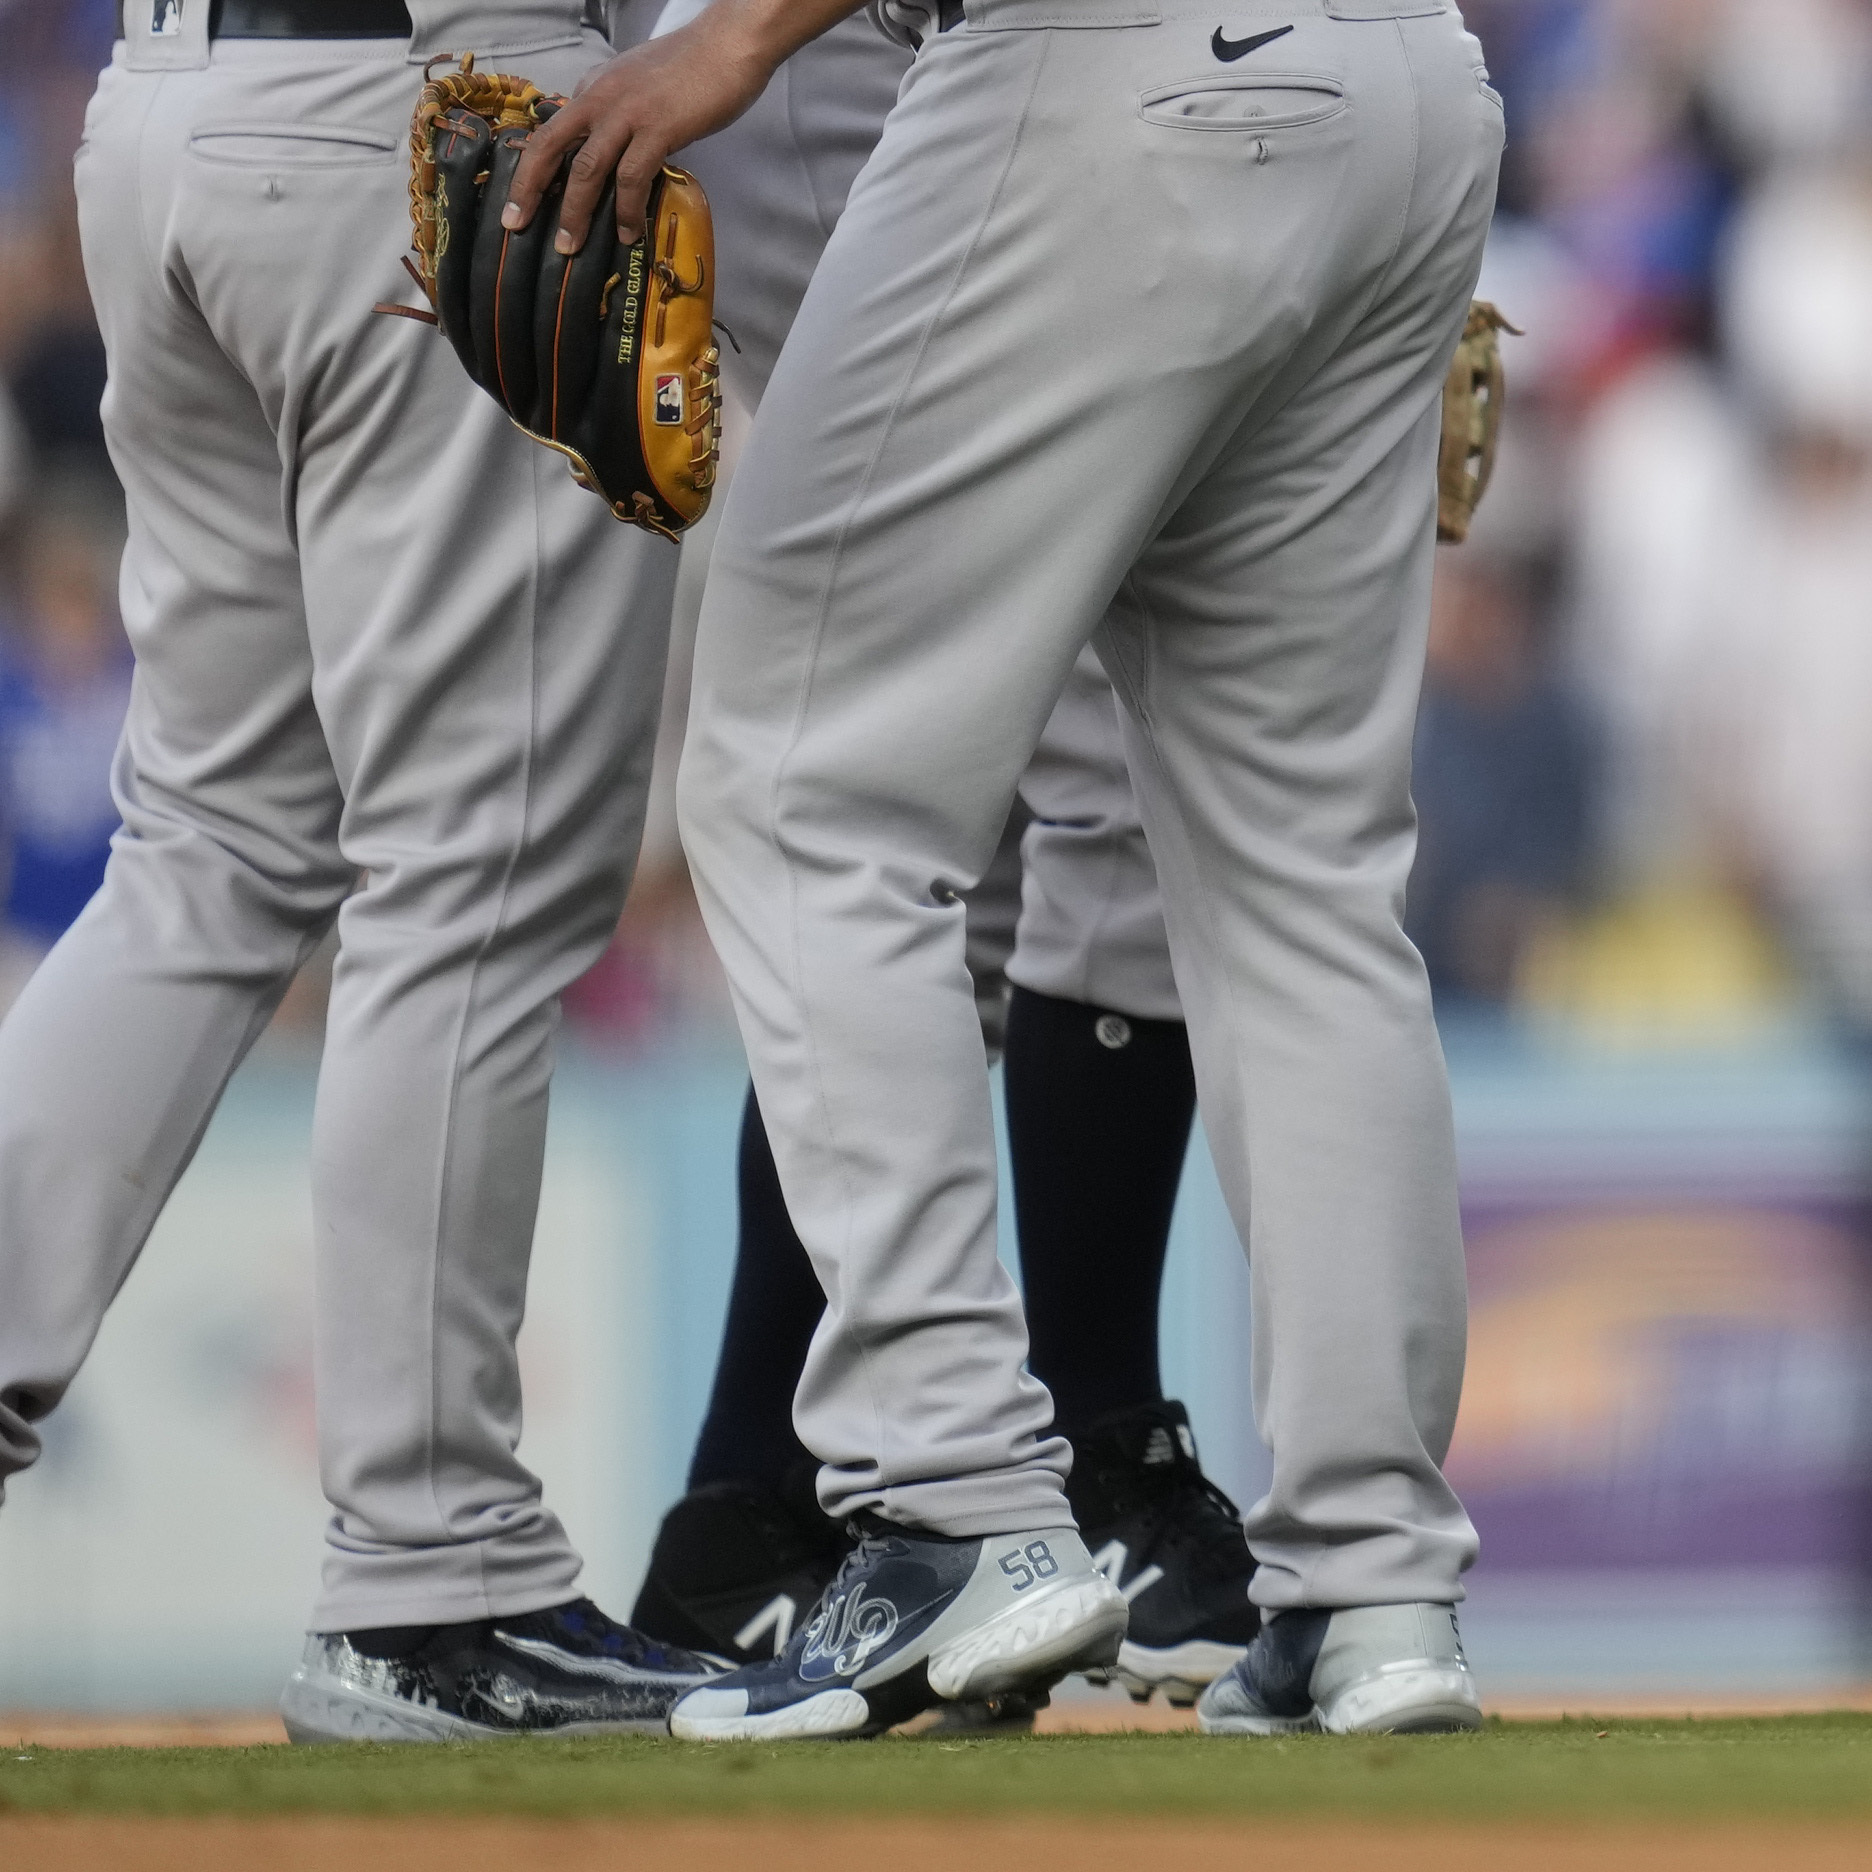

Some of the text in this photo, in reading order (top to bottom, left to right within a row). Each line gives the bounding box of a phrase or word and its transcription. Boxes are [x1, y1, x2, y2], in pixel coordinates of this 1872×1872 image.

[618, 331, 634, 365] THE
[627, 247, 645, 295] GLOVE
[997, 1539, 1060, 1593] 58
